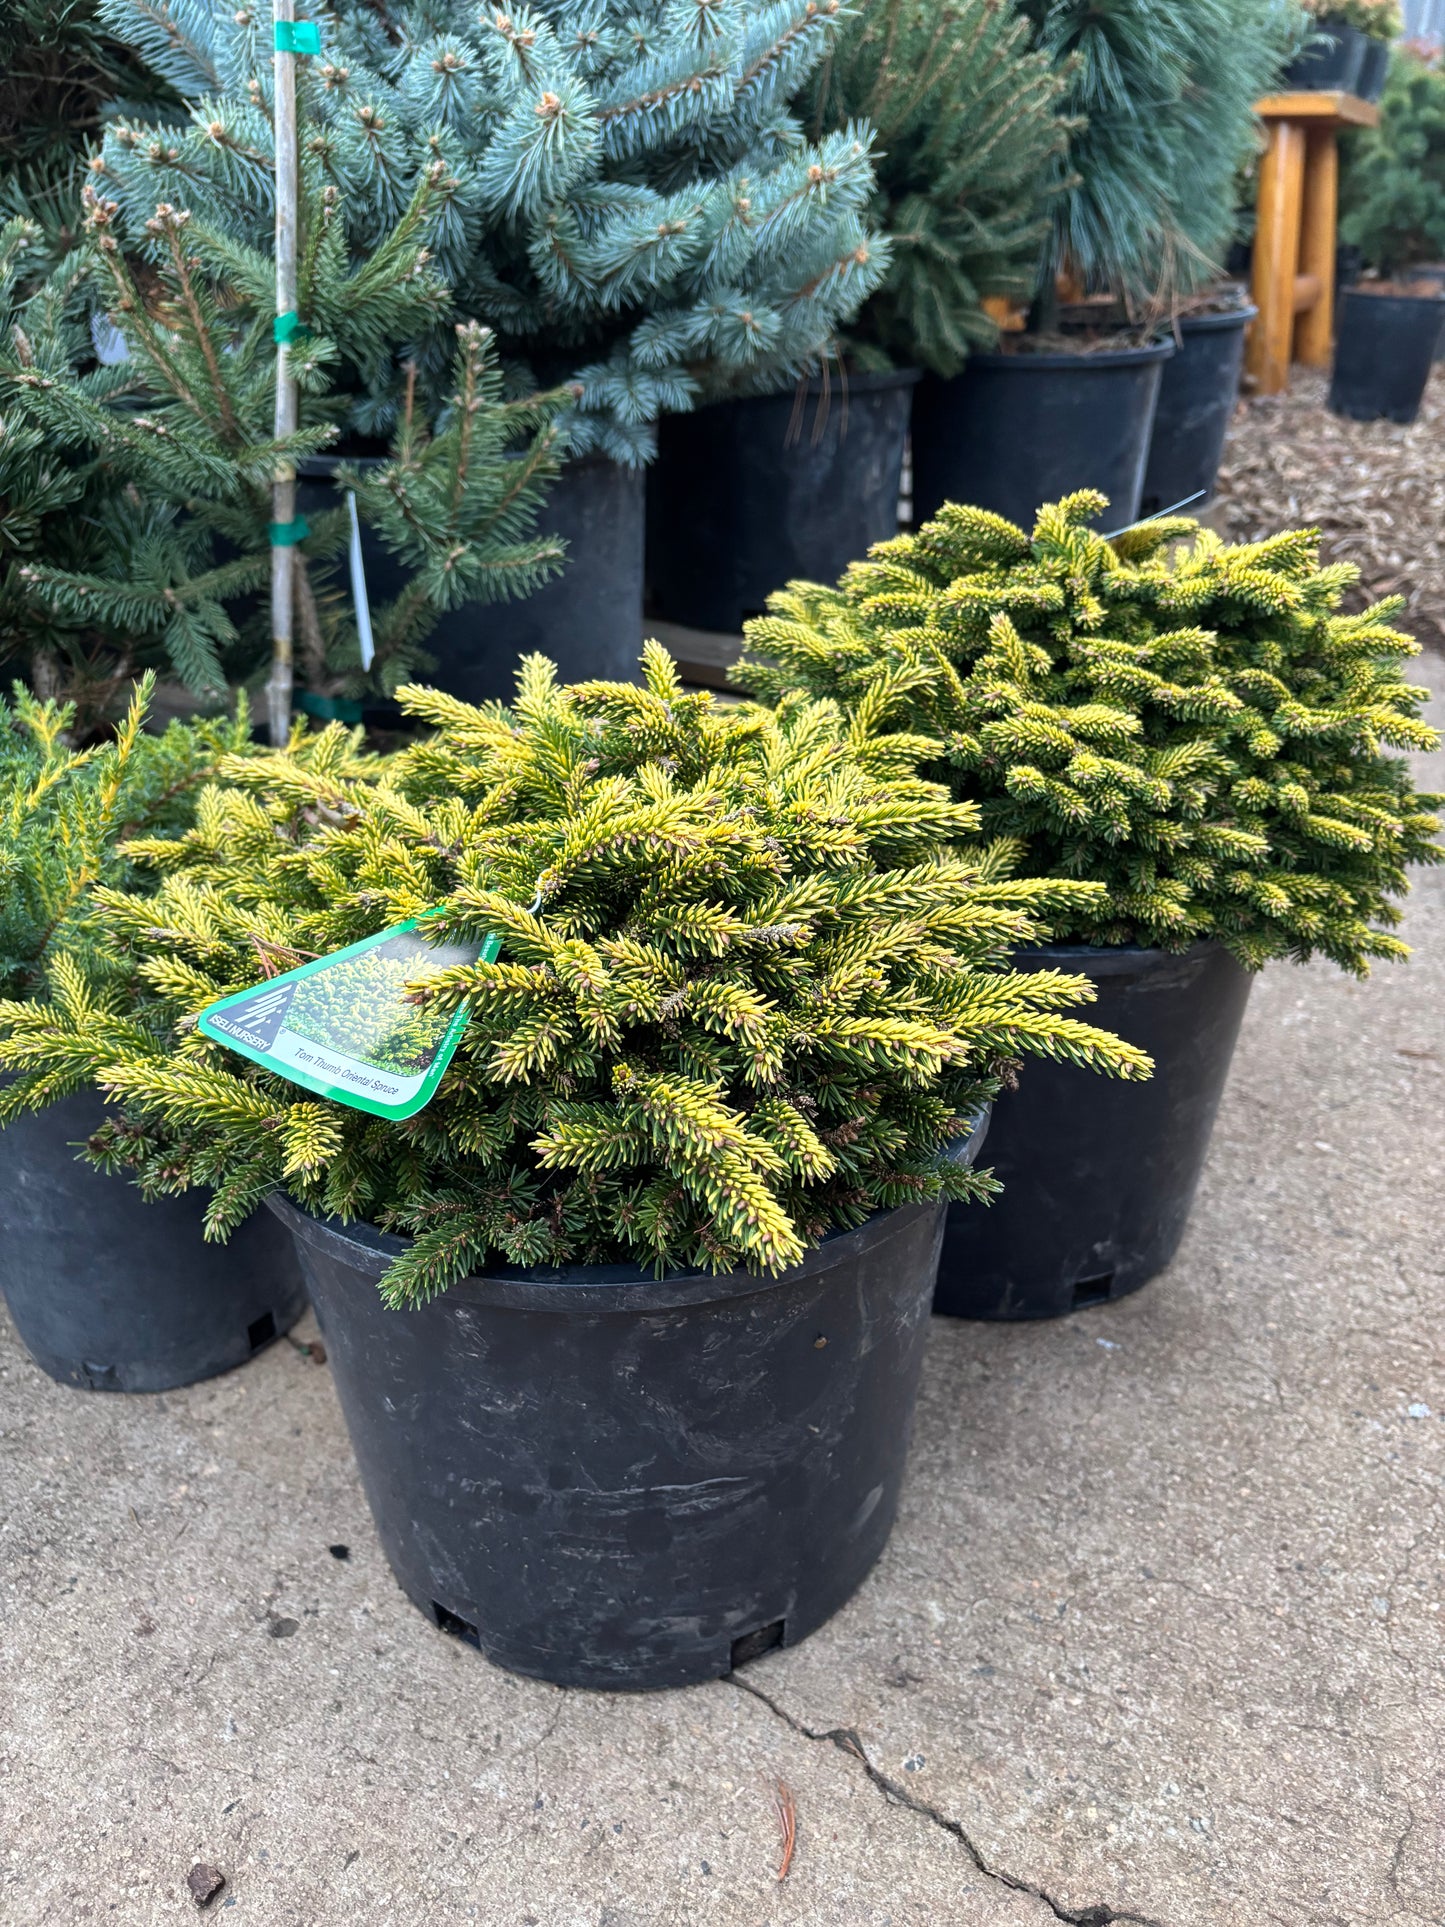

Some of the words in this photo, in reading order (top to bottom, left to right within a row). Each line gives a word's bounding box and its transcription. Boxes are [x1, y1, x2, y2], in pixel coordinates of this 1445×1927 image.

[481, 940, 494, 961] Beaut
[209, 1014, 233, 1031] ISELI
[229, 1025, 271, 1050] NURSERY
[440, 1028, 457, 1053] Artistry
[436, 1053, 444, 1061] of
[294, 1047, 314, 1062] Tom
[313, 1056, 342, 1075] Thumb
[340, 1069, 374, 1087] Oriental
[370, 1080, 399, 1095] Spruce
